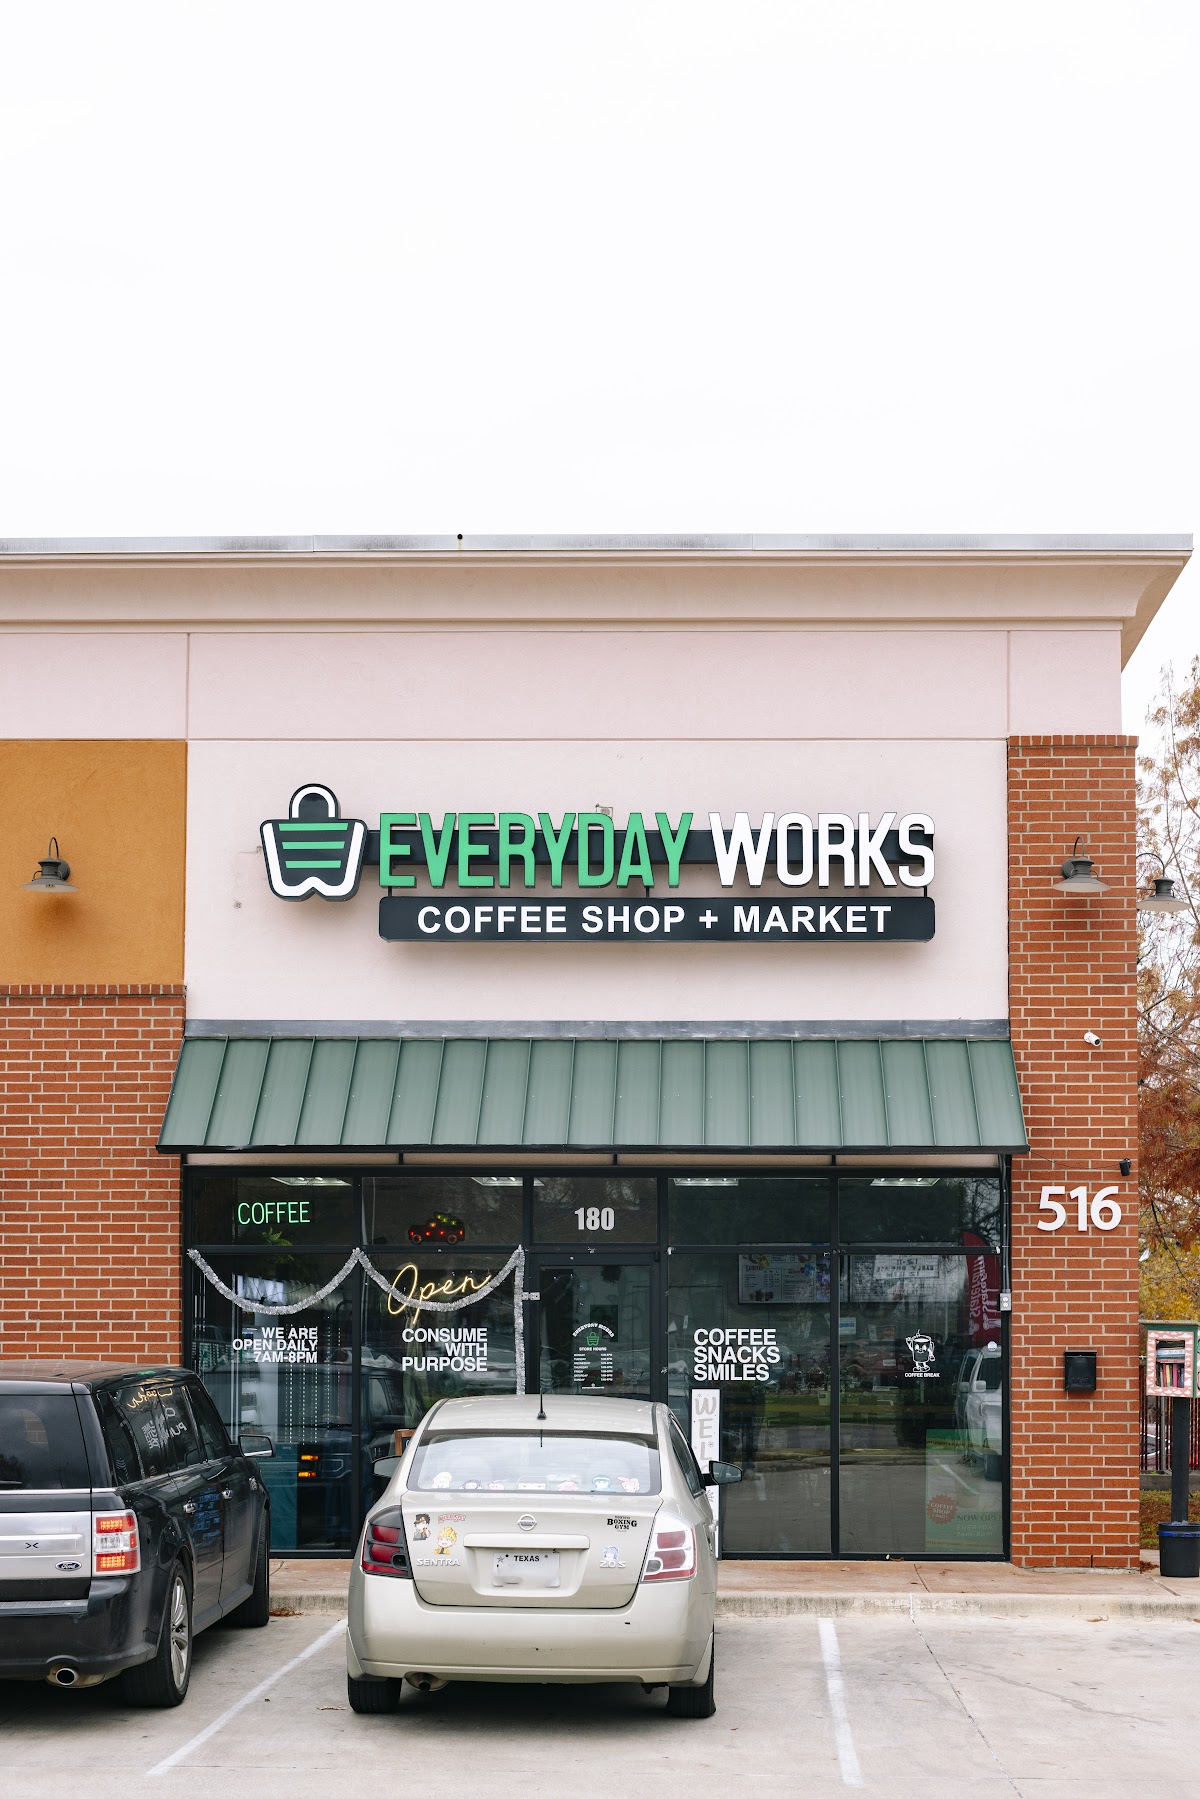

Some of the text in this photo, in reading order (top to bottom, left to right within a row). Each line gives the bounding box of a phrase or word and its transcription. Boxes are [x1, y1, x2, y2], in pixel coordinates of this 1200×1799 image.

[379, 812, 935, 889] EVERYDAY WORKS
[417, 906, 567, 933] COFFEE
[581, 906, 687, 933] SHOP
[733, 906, 892, 933] MARKET
[237, 1201, 311, 1225] COFFEE
[1037, 1186, 1122, 1231] 516
[574, 1207, 615, 1230] 180
[387, 1263, 492, 1325] Open
[261, 1327, 318, 1339] WE ARE
[402, 1328, 488, 1343] CONSUME
[694, 1328, 777, 1346] COFFEE
[232, 1339, 318, 1351] OPEN DAILY
[445, 1343, 488, 1357] WITH
[253, 1351, 318, 1363] 7AM-8PM
[694, 1346, 780, 1363] SNACKS
[402, 1357, 488, 1371] PURPOSE
[694, 1364, 770, 1381] SMILES
[694, 1396, 717, 1473] WEL
[607, 1518, 638, 1528] BOXING
